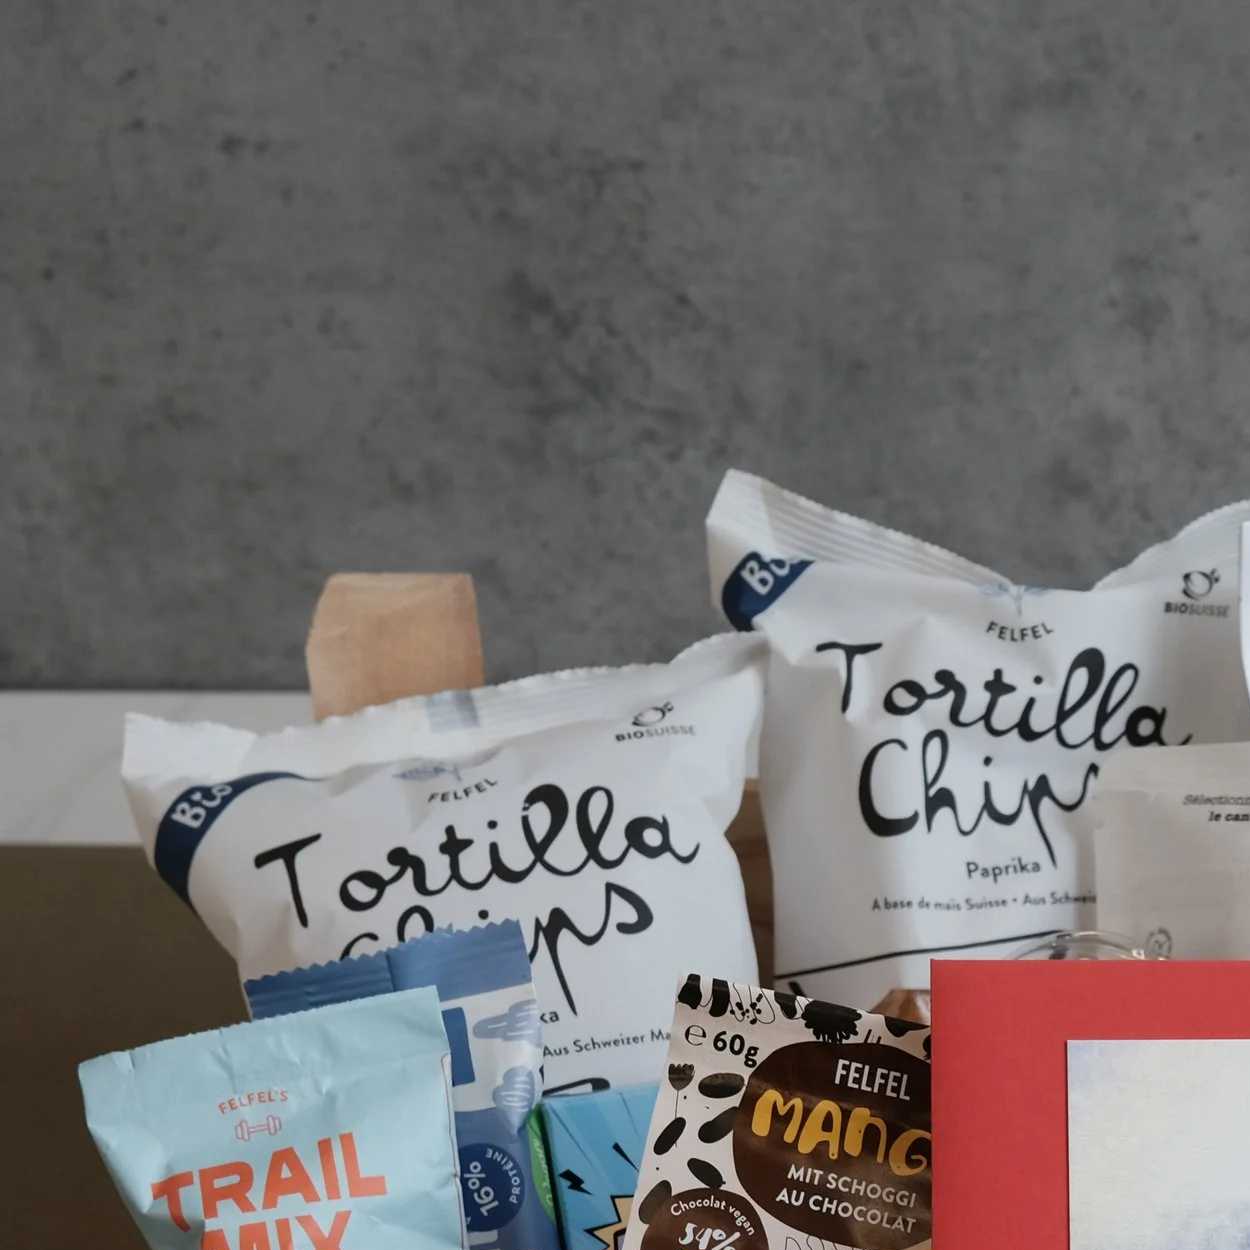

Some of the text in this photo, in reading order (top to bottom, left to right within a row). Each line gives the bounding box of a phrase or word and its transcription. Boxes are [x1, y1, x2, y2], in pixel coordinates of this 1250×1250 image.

[985, 620, 1054, 643] FELFEL
[816, 642, 1193, 750] Tortilla
[171, 783, 233, 829] Bio
[427, 776, 498, 804] FELFEL
[859, 729, 1100, 868] Chip
[1208, 811, 1222, 823] le
[254, 783, 700, 928] Tortilla
[966, 856, 1042, 884] Paprika
[884, 896, 914, 911] base
[918, 896, 931, 910] de
[965, 897, 1008, 911] Suisse
[1022, 893, 1046, 906] Aus
[542, 1045, 570, 1059] Aus
[573, 1033, 646, 1054] Schweizer
[713, 1030, 759, 1068] 60g
[834, 1058, 911, 1101] FELFEL
[751, 1089, 932, 1176] MANG
[150, 1132, 387, 1232] TRAIL
[787, 1164, 917, 1208] MIT SCHOGGI
[670, 1195, 755, 1236] Chocolat vegan
[775, 1187, 917, 1234] AU CHOCOLAT
